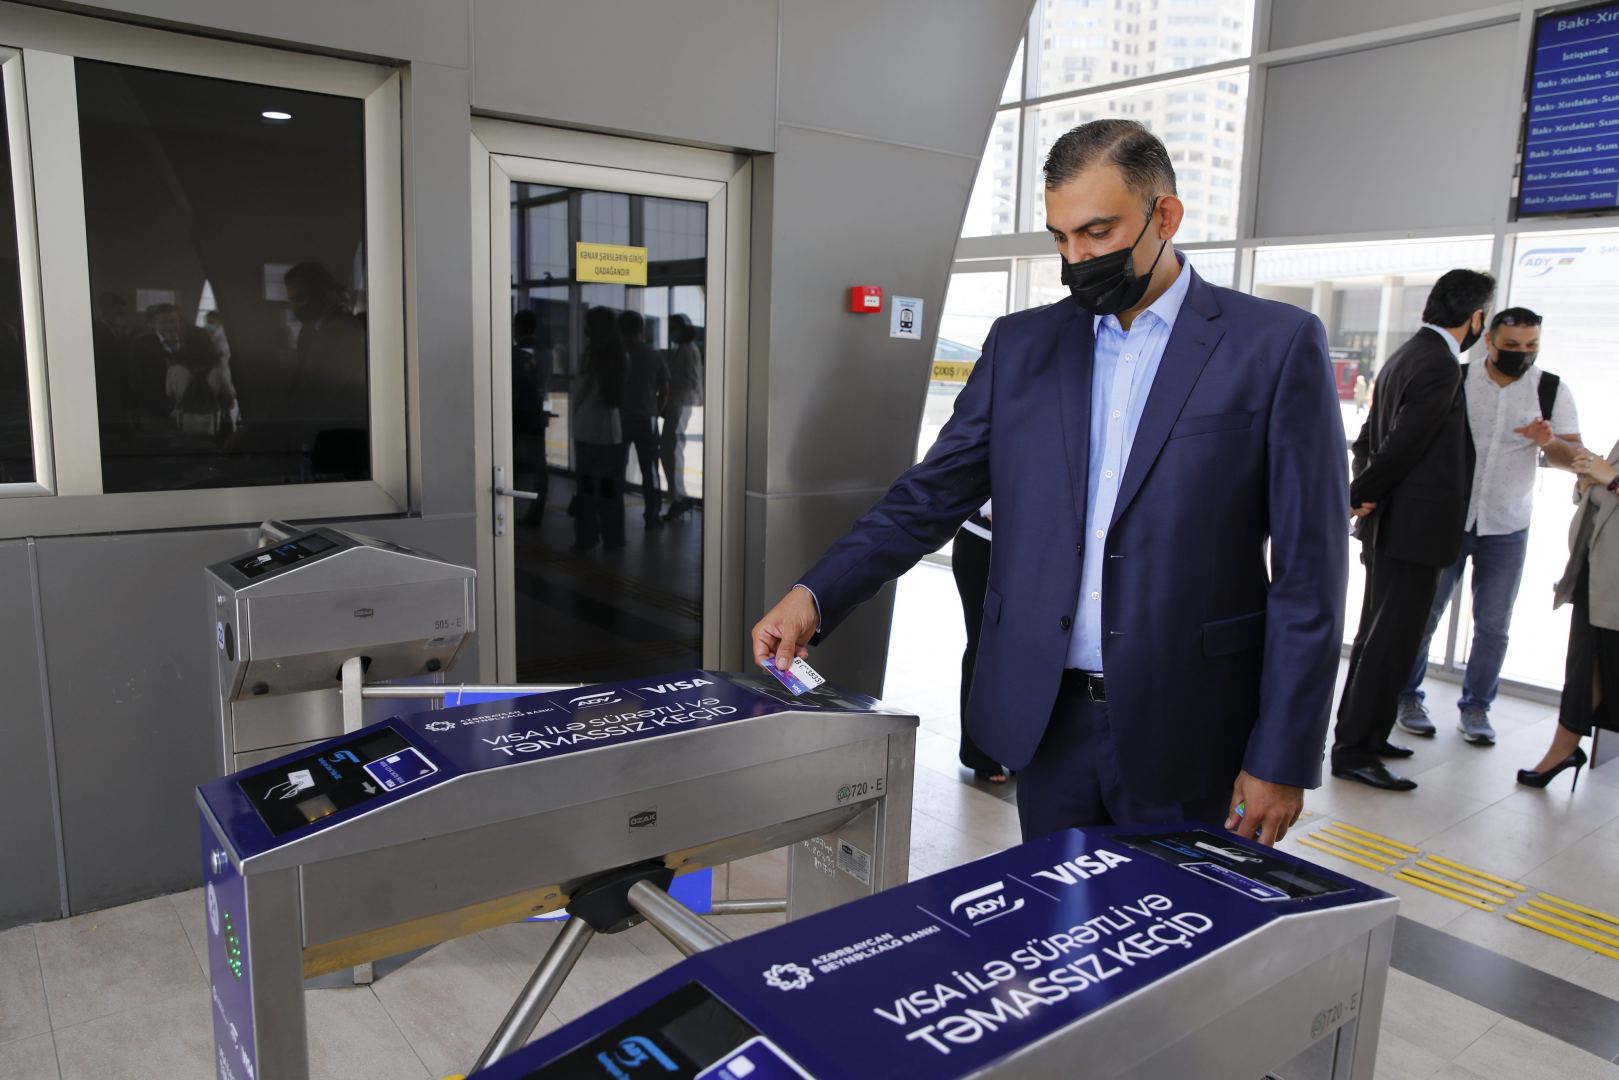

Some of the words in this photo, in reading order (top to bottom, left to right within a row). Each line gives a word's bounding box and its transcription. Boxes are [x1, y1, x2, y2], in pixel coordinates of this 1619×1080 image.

[435, 619, 449, 630] 505
[639, 678, 715, 694] VISA
[481, 729, 544, 745] VISA
[544, 722, 586, 735] İLƏ
[588, 702, 686, 727] SÜRƏTLİ
[685, 697, 720, 708] VƏ
[492, 721, 655, 756] TƏMASSIZ
[651, 705, 738, 727] KEÇİD
[851, 782, 868, 797] 720
[876, 778, 883, 791] E
[1031, 849, 1133, 886] VISA
[811, 932, 894, 967] AZƏRBAYCAN
[818, 939, 904, 974] BEYNƏLXALQ
[901, 924, 942, 944] BANKI
[873, 982, 967, 1026] VISA
[951, 960, 1017, 994] İLƏ
[1011, 905, 1136, 970] SÜRƏTLİ
[1122, 894, 1174, 918] VƏ
[905, 953, 1123, 1055] TƏMASSIZ
[1102, 911, 1215, 967] KEÇİD
[1326, 1001, 1343, 1027] 720
